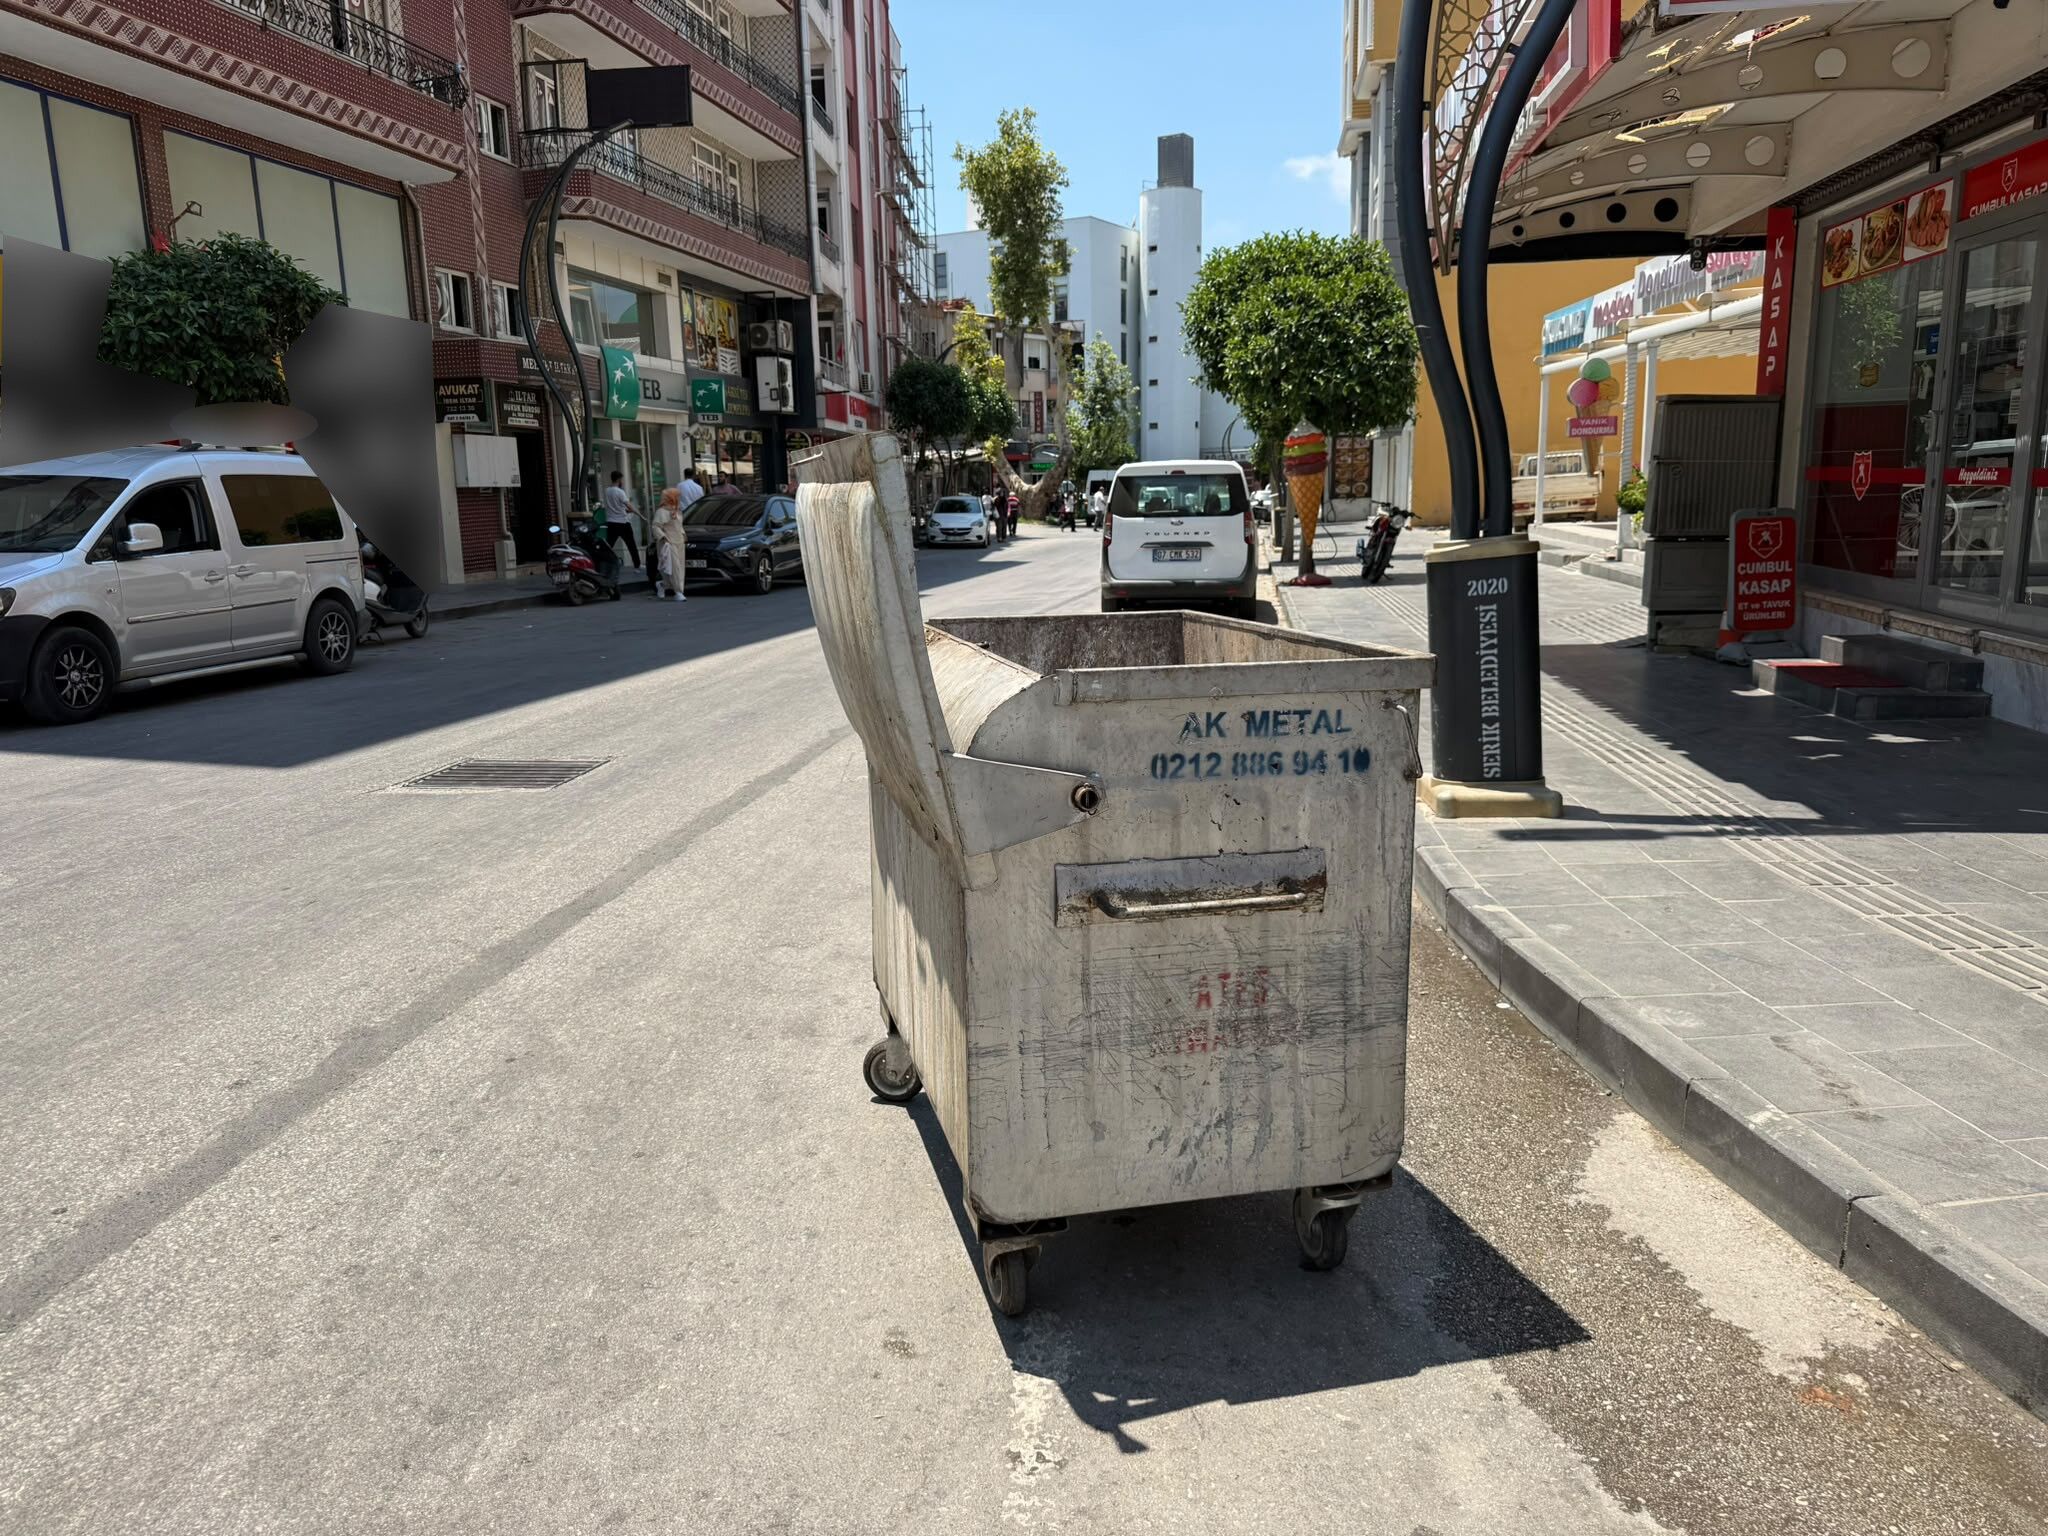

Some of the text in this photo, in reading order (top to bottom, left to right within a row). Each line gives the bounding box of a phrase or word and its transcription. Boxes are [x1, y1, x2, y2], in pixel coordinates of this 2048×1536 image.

[2009, 181, 2048, 207] KASAP
[1763, 235, 1785, 378] KASAP
[438, 383, 480, 397] AVUKAT
[701, 414, 719, 422] TEB
[1185, 550, 1199, 560] 532
[1737, 560, 1793, 576] CUMBUL
[1467, 577, 1509, 597] 2020
[1738, 578, 1792, 596] KASAP
[1738, 602, 1749, 611] ET
[1762, 599, 1791, 609] TAVUK
[1474, 603, 1501, 779] SERİK BELEDİYESİ
[1178, 708, 1352, 743] AK METAL
[1151, 752, 1222, 780] 0212
[1231, 751, 1283, 777] 886
[1292, 751, 1326, 777] 94
